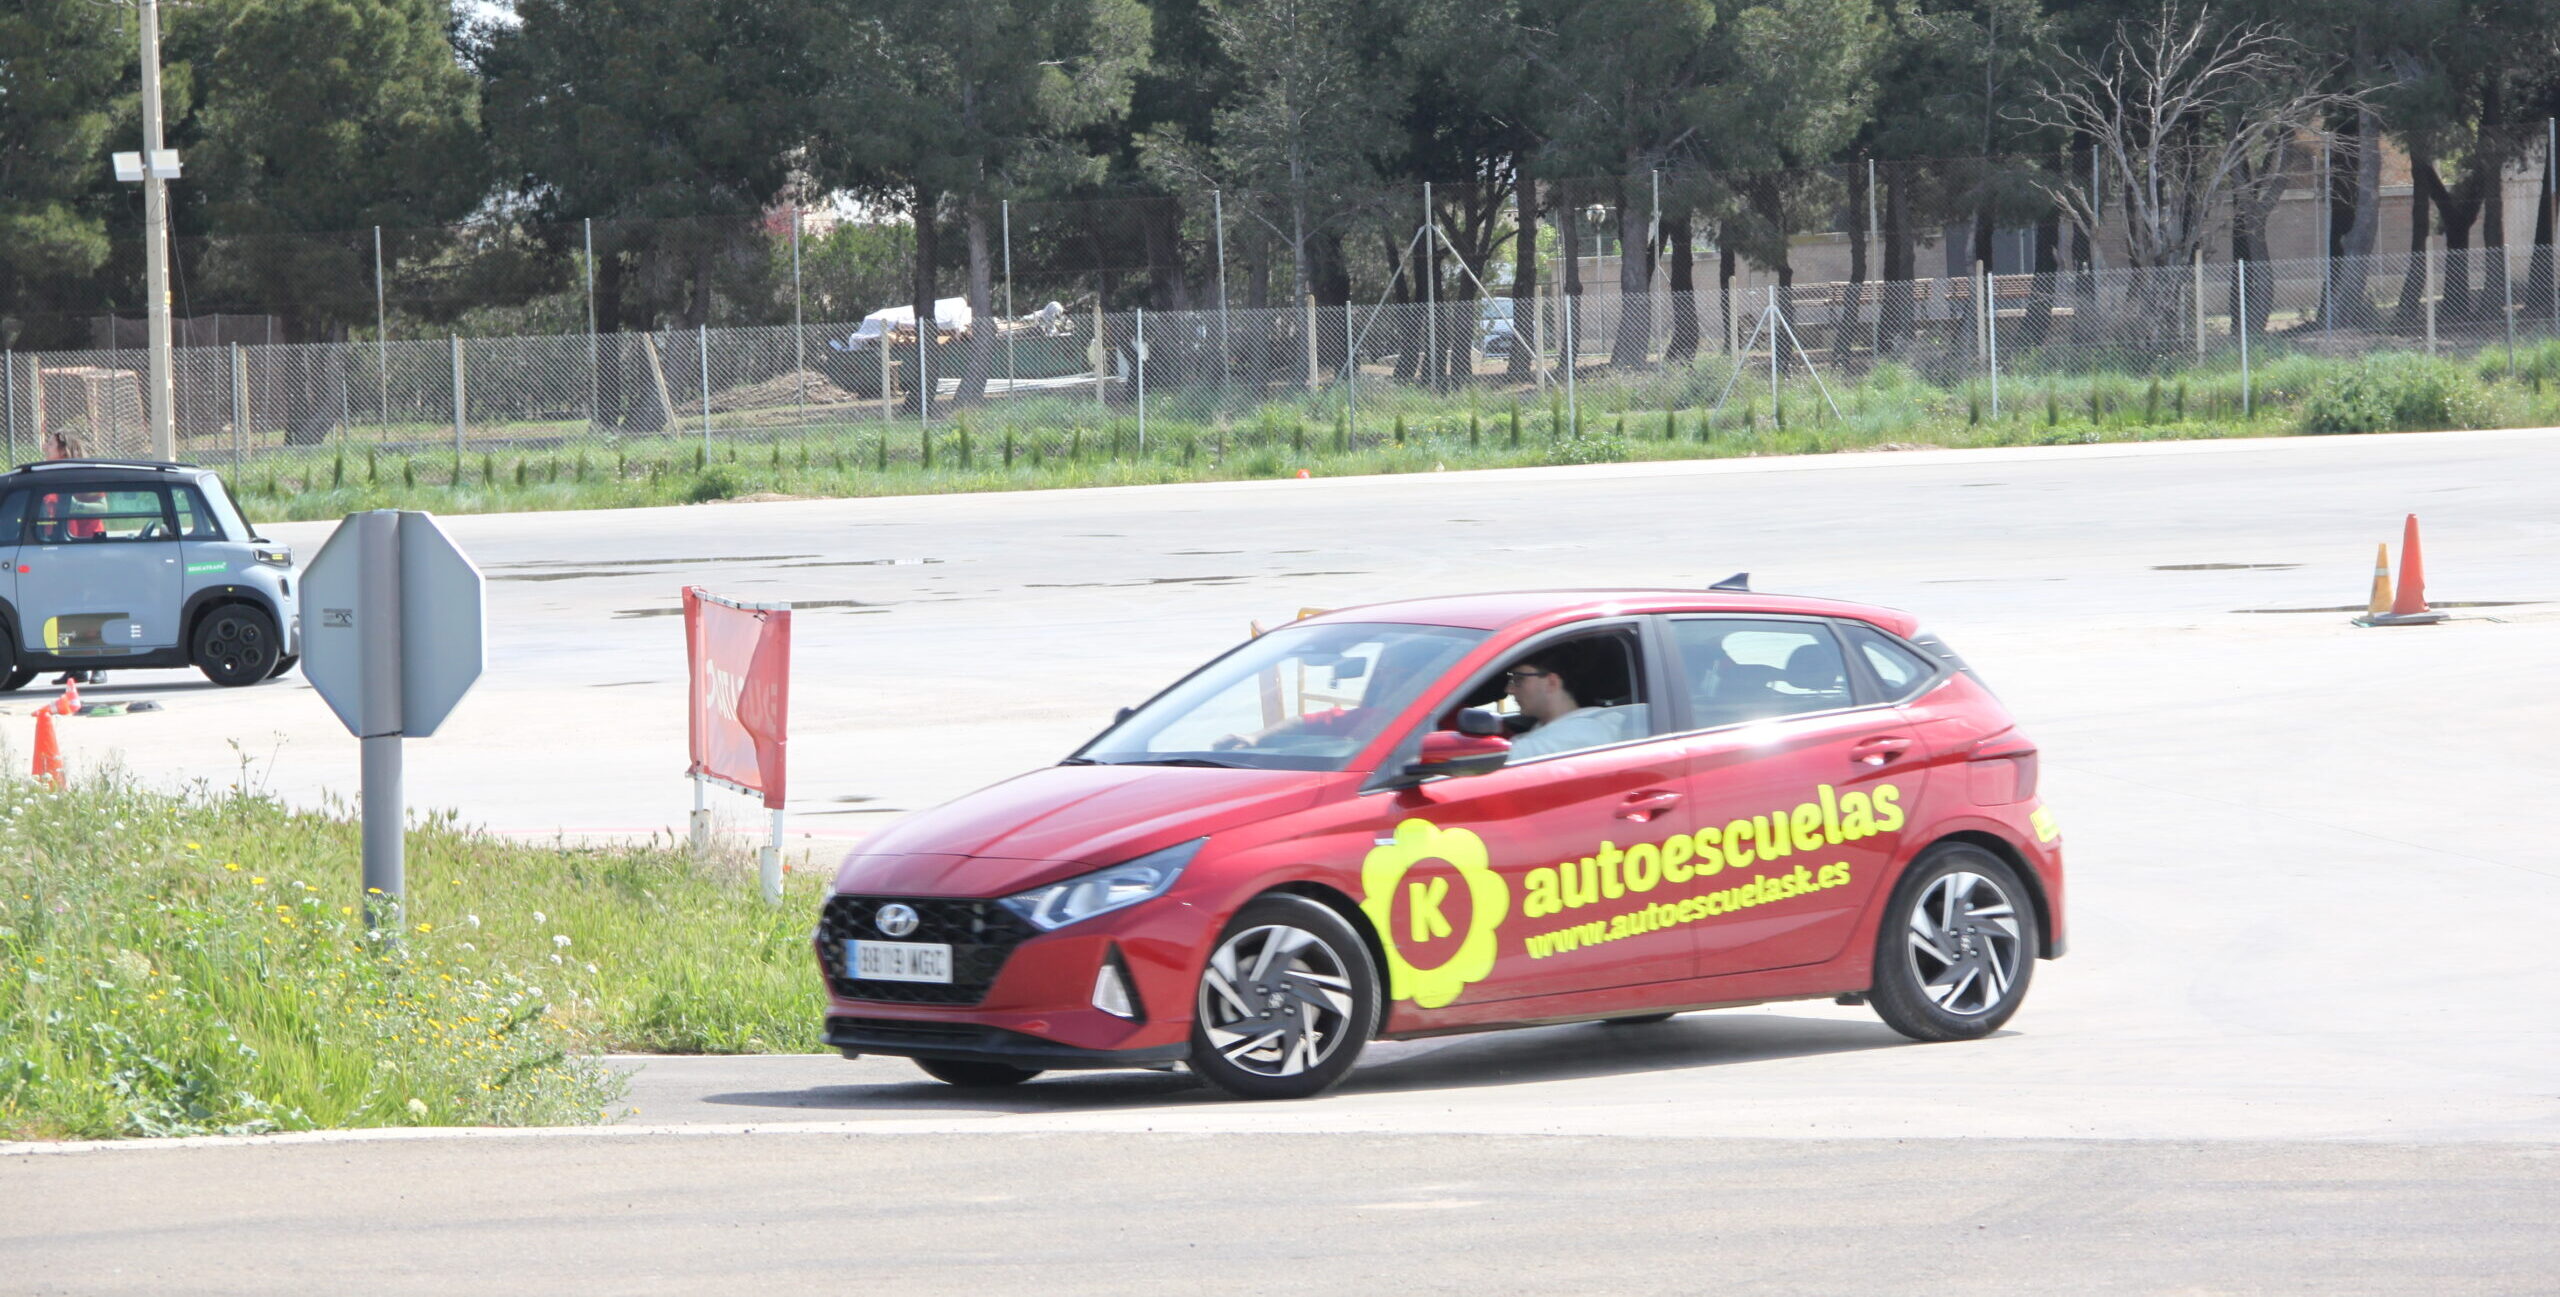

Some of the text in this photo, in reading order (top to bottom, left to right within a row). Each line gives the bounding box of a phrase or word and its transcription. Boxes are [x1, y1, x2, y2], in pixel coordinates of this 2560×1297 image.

[1524, 784, 1905, 917] autoescuelas
[1409, 877, 1452, 943] K
[1526, 860, 1851, 959] www.autoescuelask.es
